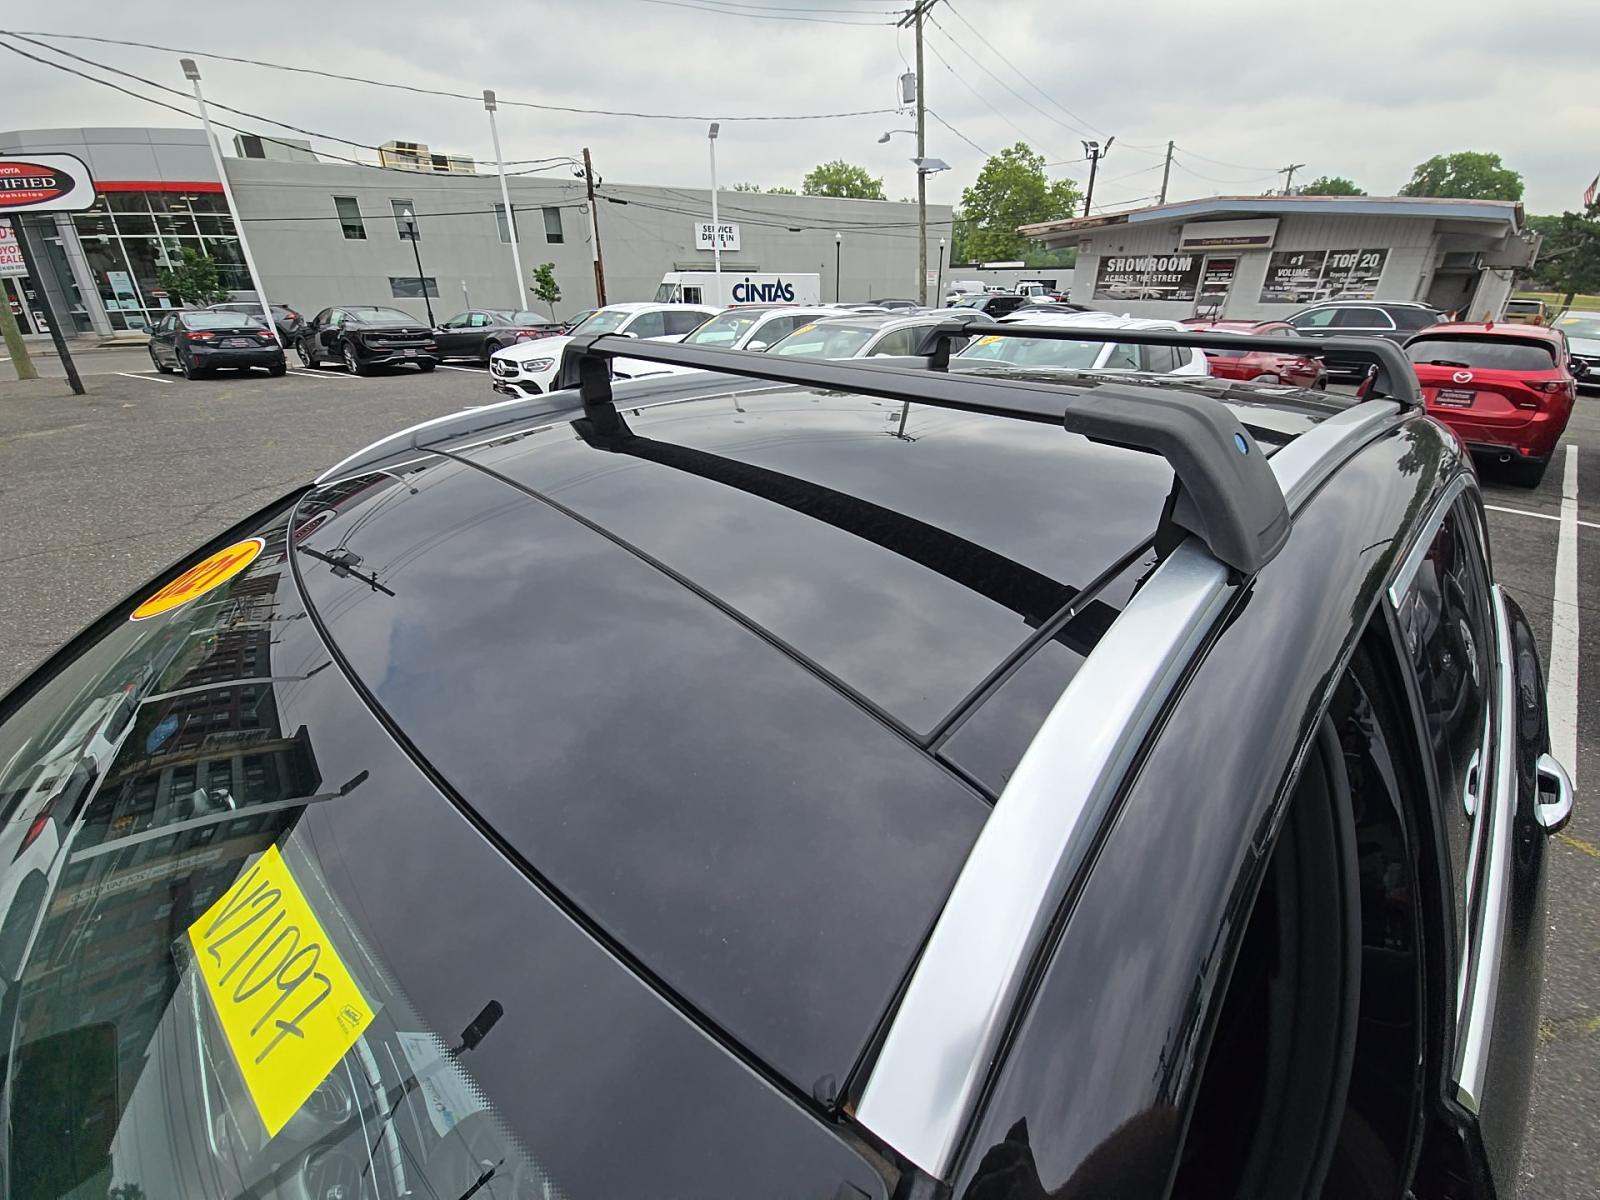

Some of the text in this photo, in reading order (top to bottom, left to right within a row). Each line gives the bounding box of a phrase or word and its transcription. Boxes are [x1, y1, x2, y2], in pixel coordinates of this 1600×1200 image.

[0, 167, 20, 175] YOTA
[0, 178, 56, 189] IFIED
[1107, 257, 1193, 272] SHOWROOM
[1290, 254, 1304, 266] #1
[1360, 253, 1380, 267] 20
[1104, 274, 1134, 282] ACROSS
[1152, 274, 1183, 282] STREET
[1277, 268, 1311, 277] VOLUME
[732, 276, 795, 303] CINTAS
